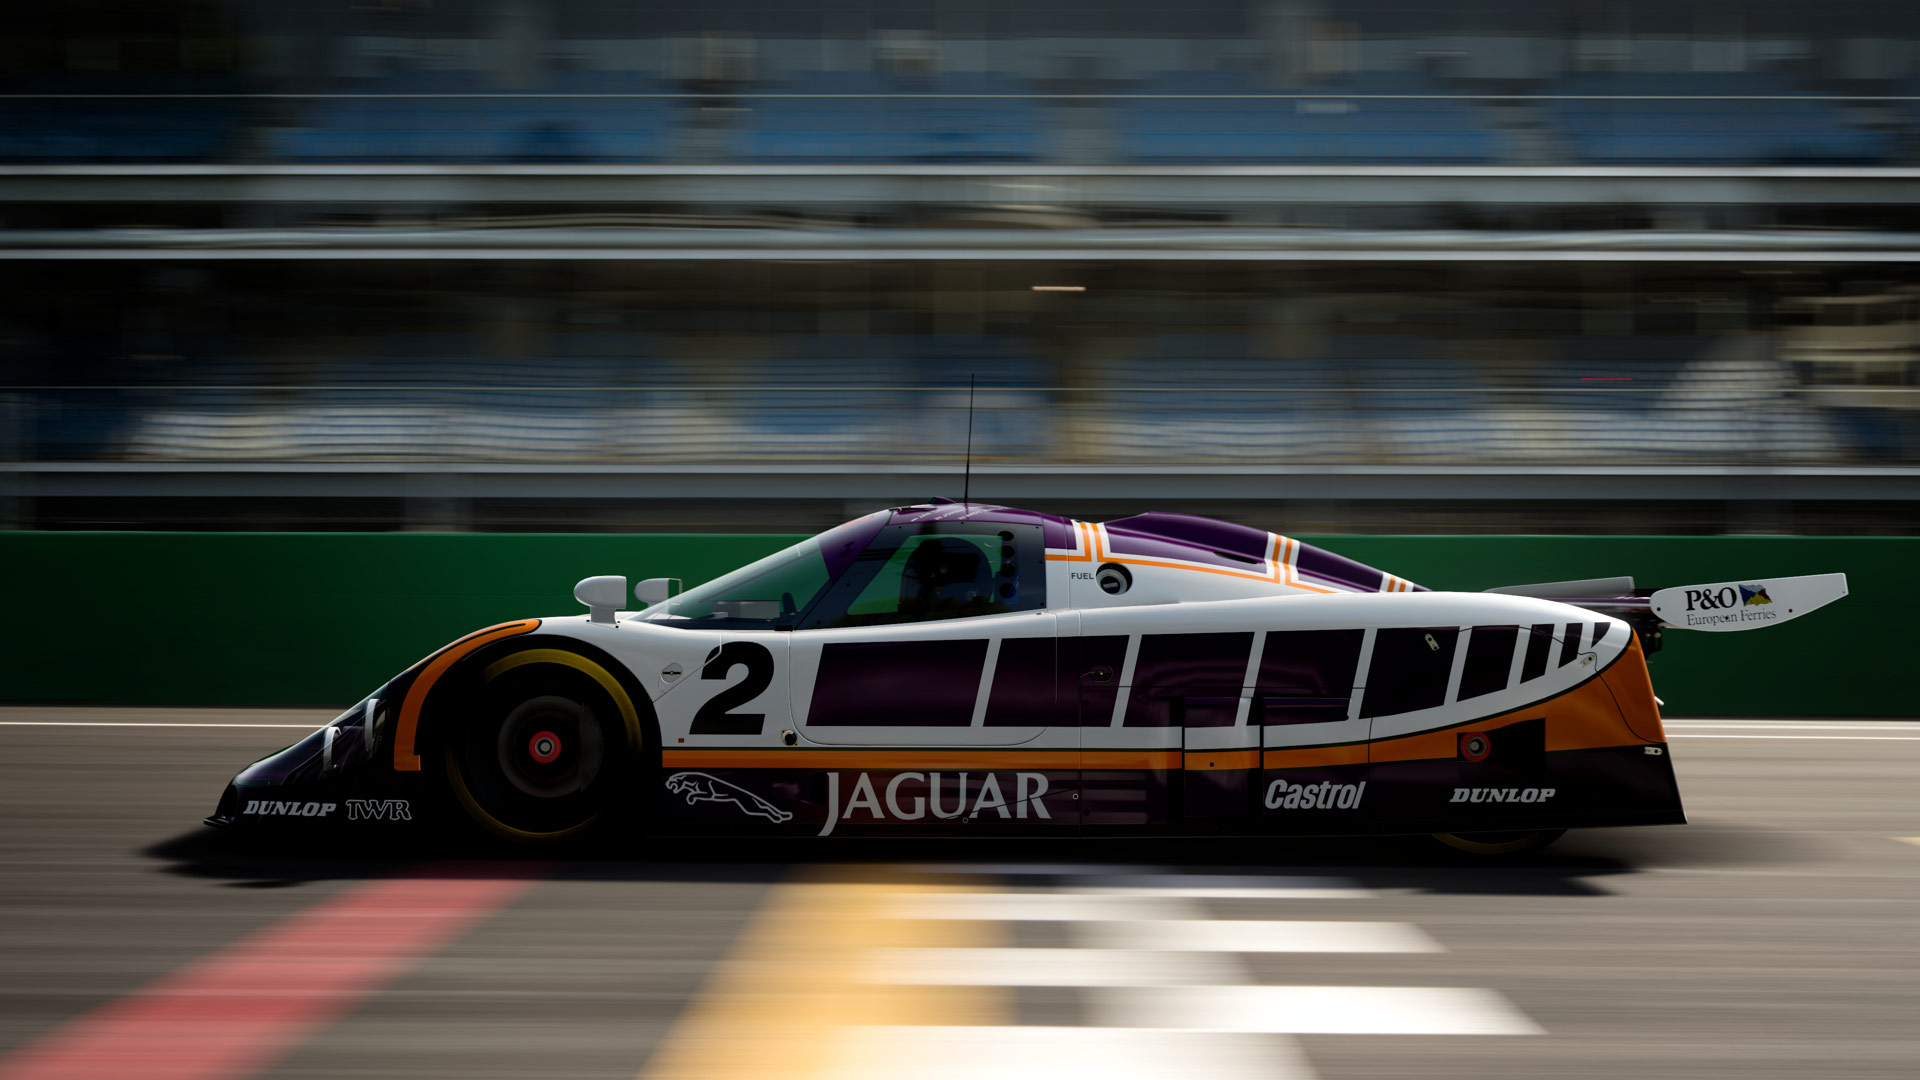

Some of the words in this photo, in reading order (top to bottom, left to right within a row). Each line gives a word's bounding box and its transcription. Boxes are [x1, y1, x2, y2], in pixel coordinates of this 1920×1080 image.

[1071, 572, 1095, 580] FUEL
[1685, 587, 1737, 611] P&O
[1687, 613, 1738, 626] European
[1741, 610, 1776, 622] Ferries
[689, 640, 775, 735] 2
[817, 771, 1052, 837] JAGUAR
[1264, 779, 1367, 810] Castrol
[1449, 788, 1556, 803] DUNLOP
[243, 799, 337, 817] DUNLOP
[345, 799, 413, 821] TWR
